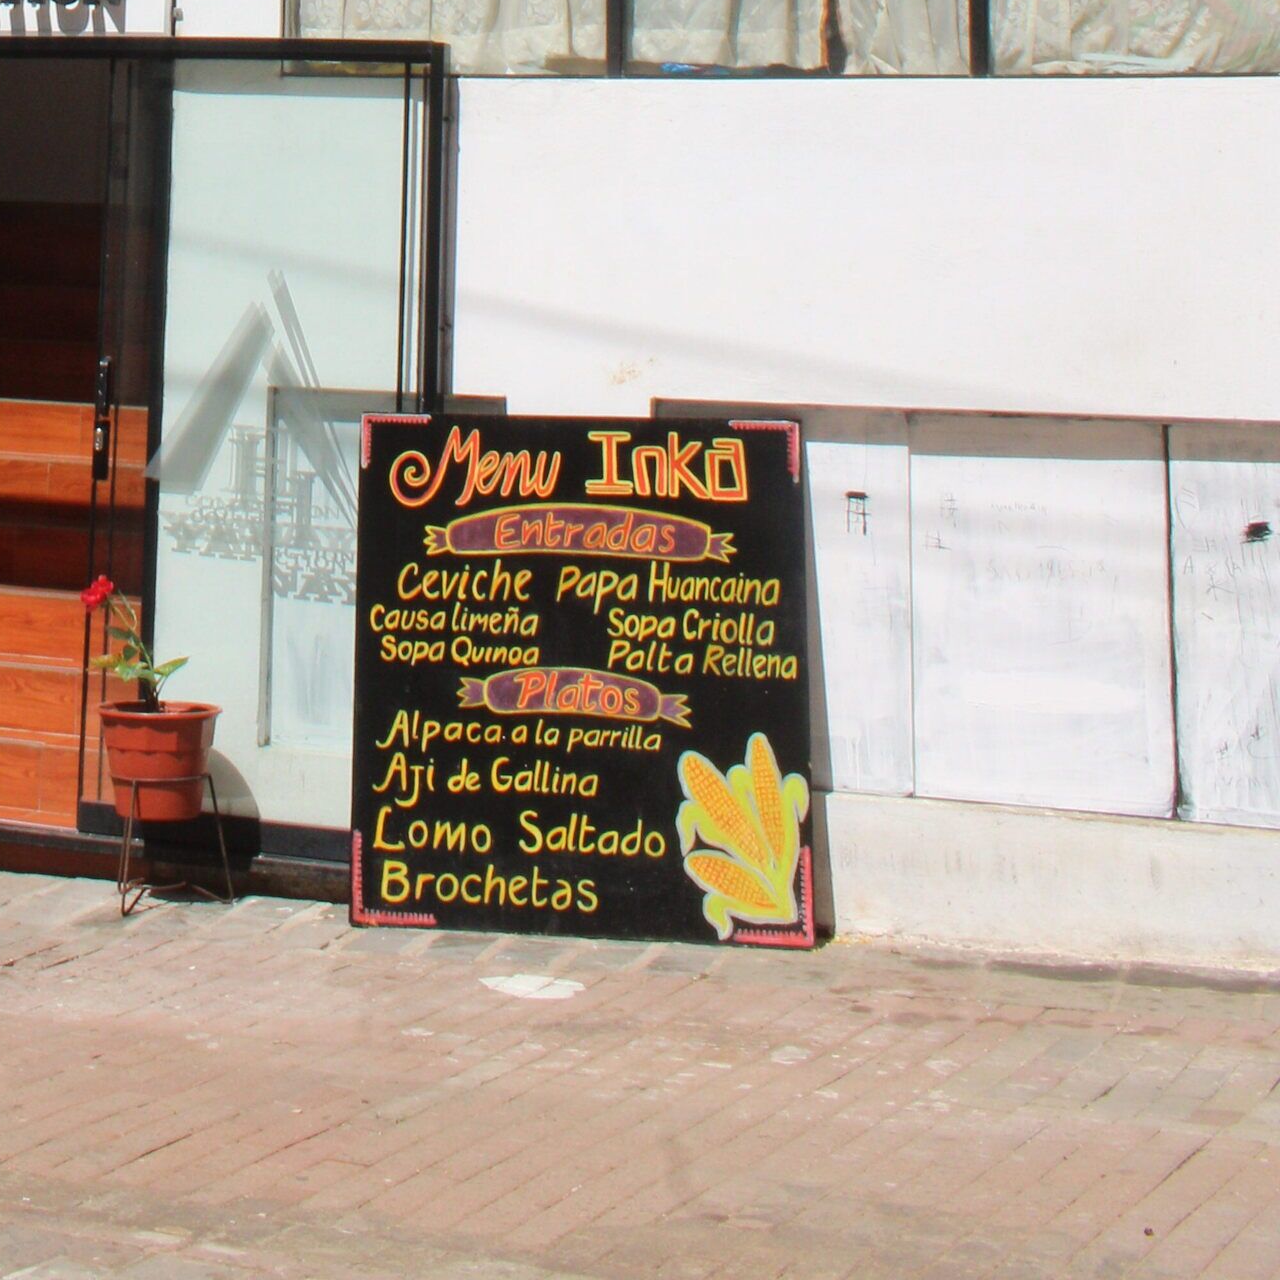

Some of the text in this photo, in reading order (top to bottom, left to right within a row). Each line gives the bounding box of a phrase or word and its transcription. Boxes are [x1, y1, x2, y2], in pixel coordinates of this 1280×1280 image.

[389, 426, 560, 506] Menu
[495, 513, 675, 554] Entradas
[397, 560, 532, 602] Ceviche
[648, 562, 779, 607] Huancaina
[370, 602, 538, 636] Causa limeña
[607, 609, 774, 646] Sopa Criolla
[380, 636, 540, 666] Sopa Quinoa
[608, 641, 798, 680] Palta Rellena
[515, 671, 641, 713] Platos
[375, 709, 502, 752] Alpaca
[534, 718, 560, 746] la
[567, 723, 661, 752] parrilla
[447, 758, 481, 793] de
[491, 757, 598, 797] Gallina
[373, 806, 665, 858] Lomo Saltado
[381, 861, 598, 912] Brochetas
